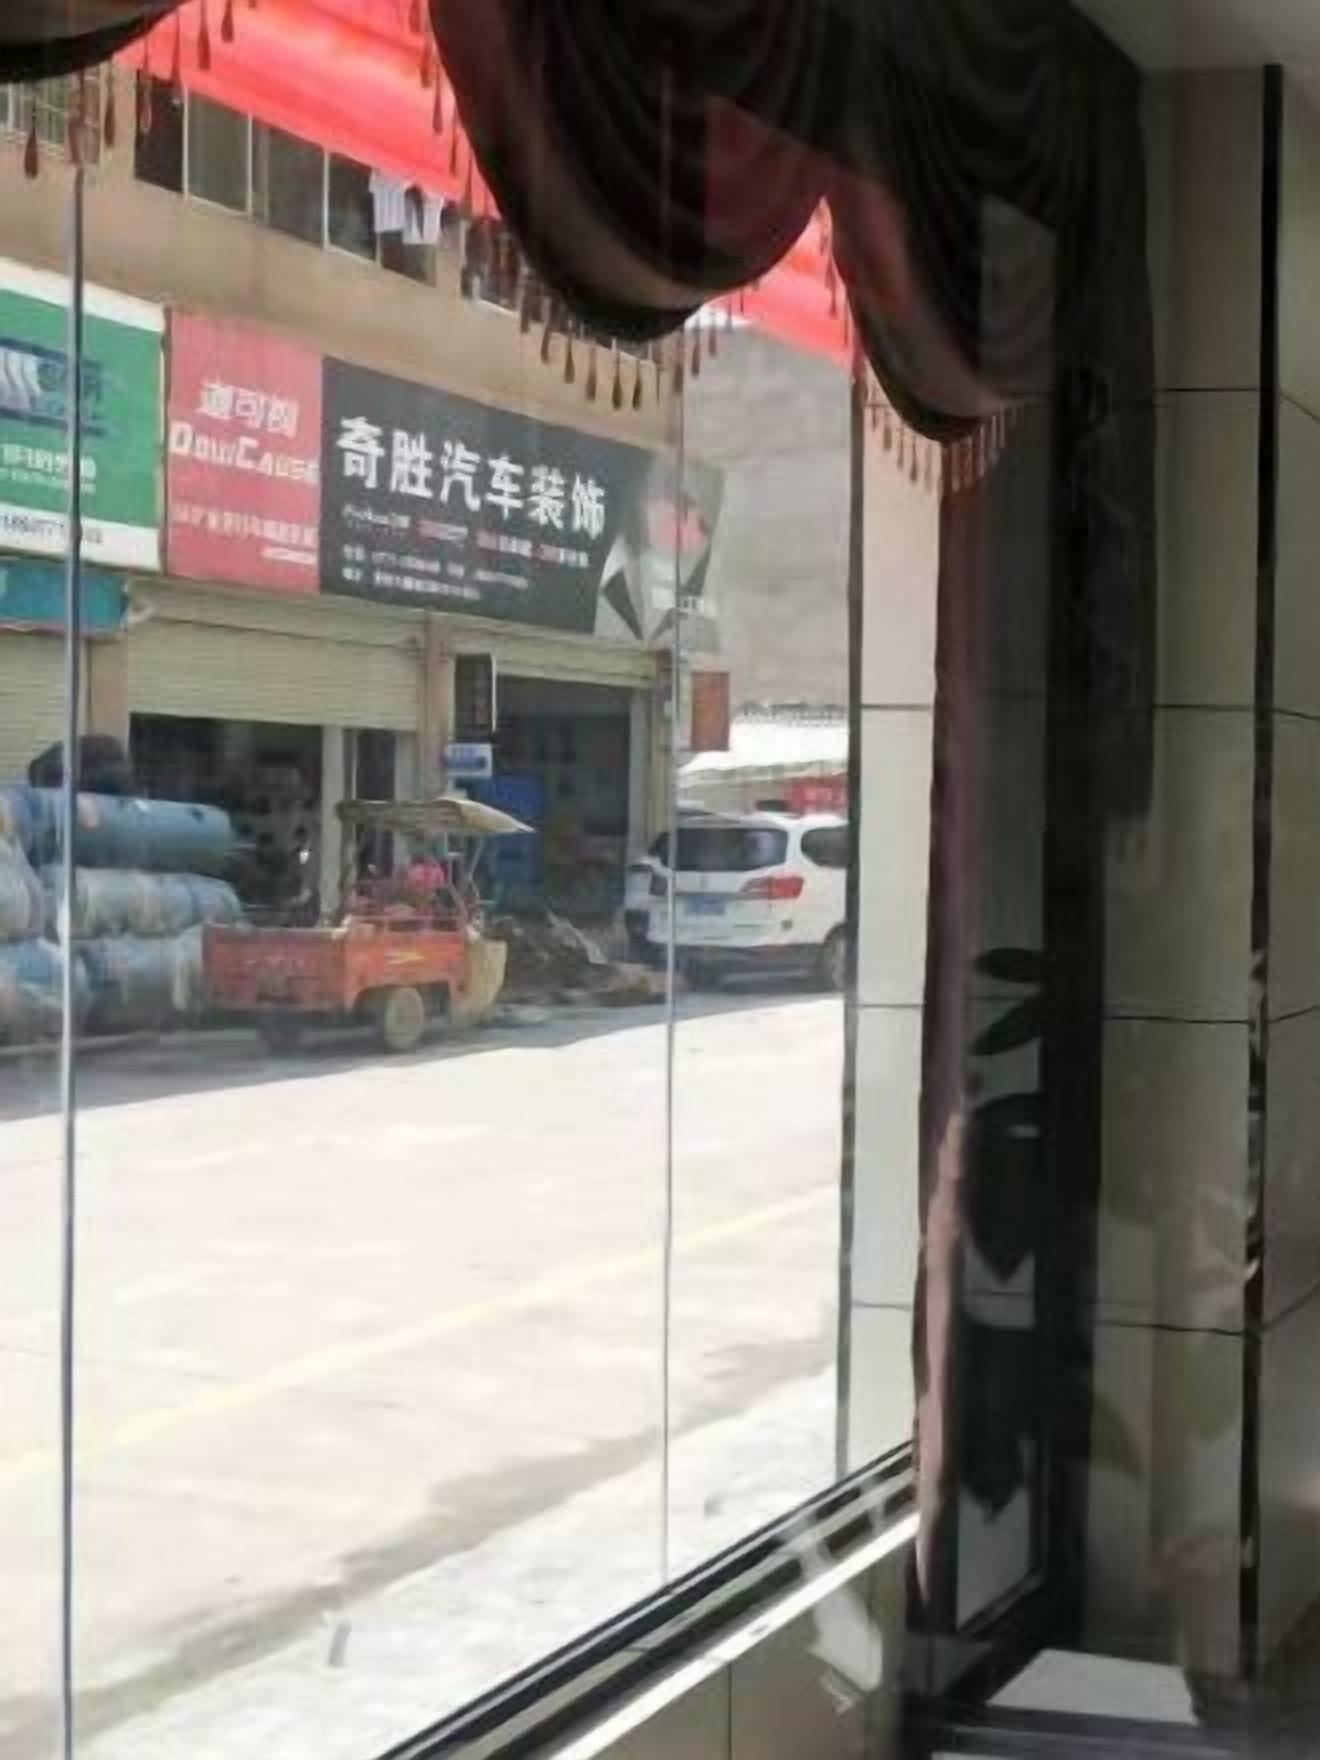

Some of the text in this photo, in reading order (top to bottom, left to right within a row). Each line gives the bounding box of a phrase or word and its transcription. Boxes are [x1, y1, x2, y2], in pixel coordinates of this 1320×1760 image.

[336, 416, 606, 540] 奇胜汽车装饰
